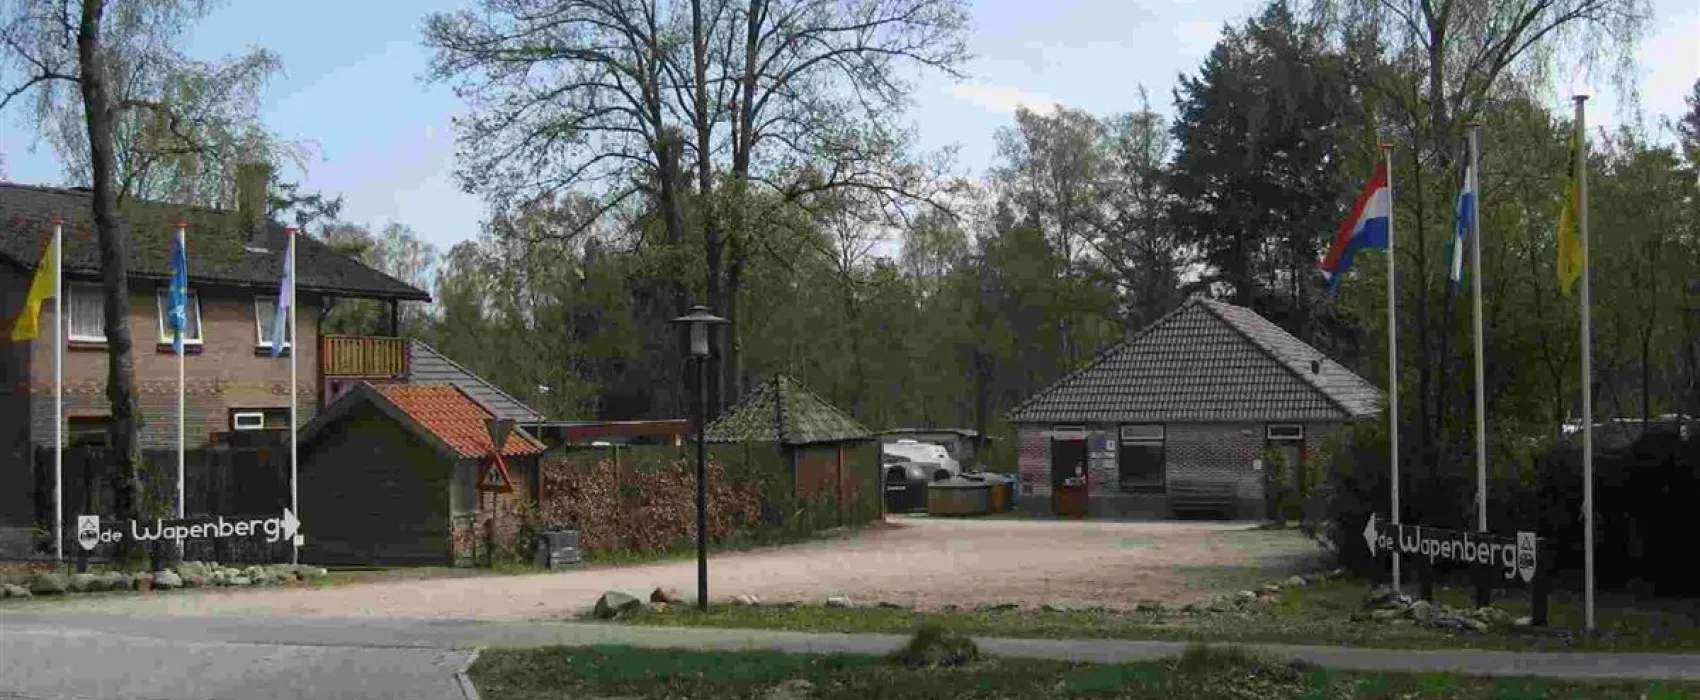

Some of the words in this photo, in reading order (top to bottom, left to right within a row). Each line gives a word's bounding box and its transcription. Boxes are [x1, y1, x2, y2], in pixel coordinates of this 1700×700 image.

[101, 528, 123, 543] de
[131, 515, 281, 545] Wapenberg
[1377, 530, 1394, 550] de
[1399, 522, 1517, 579] Wapenberg
